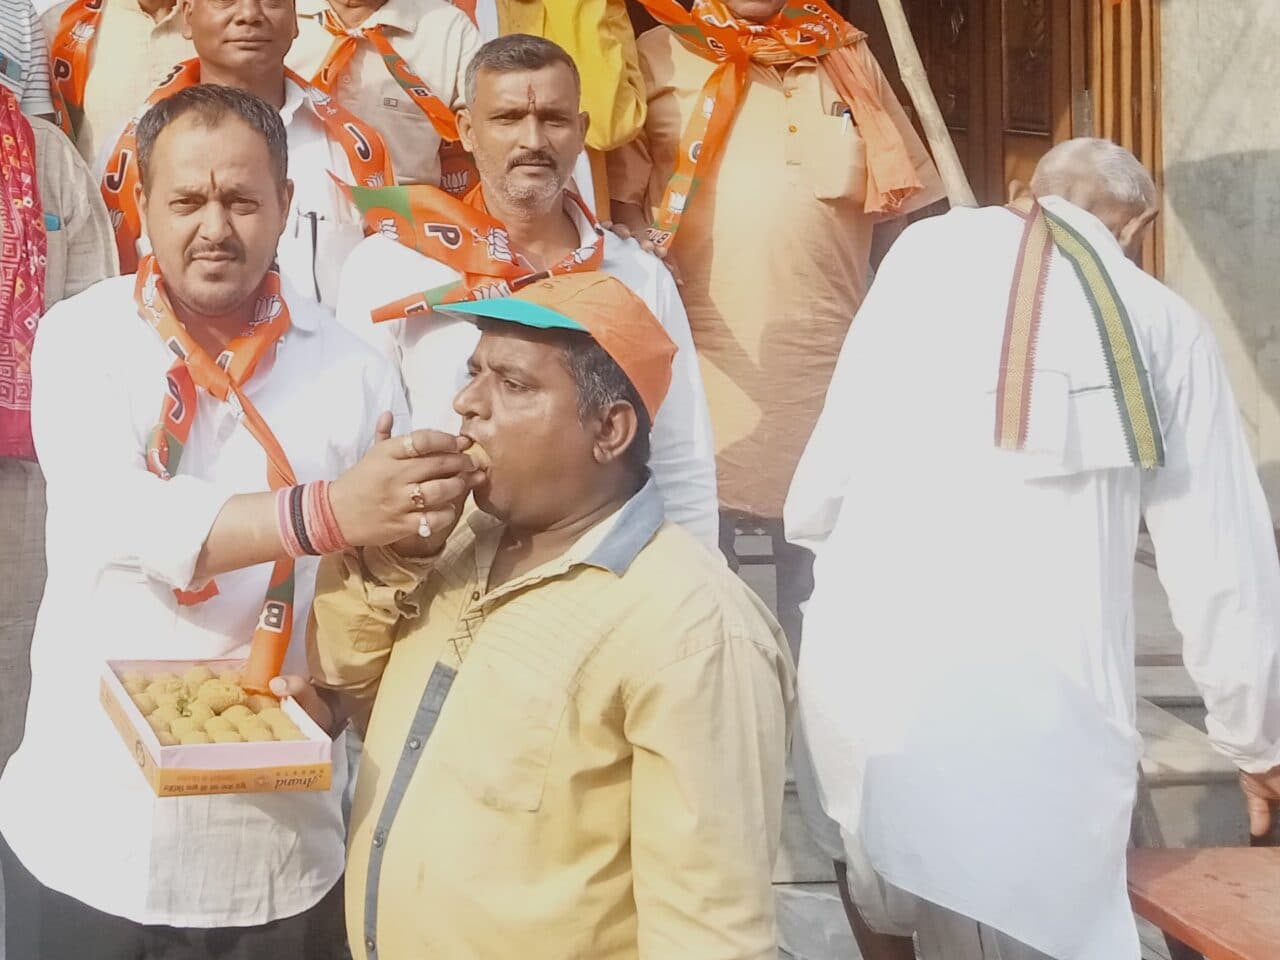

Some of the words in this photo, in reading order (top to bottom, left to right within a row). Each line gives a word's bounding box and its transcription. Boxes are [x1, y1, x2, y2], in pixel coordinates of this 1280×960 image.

[343, 122, 372, 163] J
[104, 148, 133, 194] J
[423, 222, 463, 250] P
